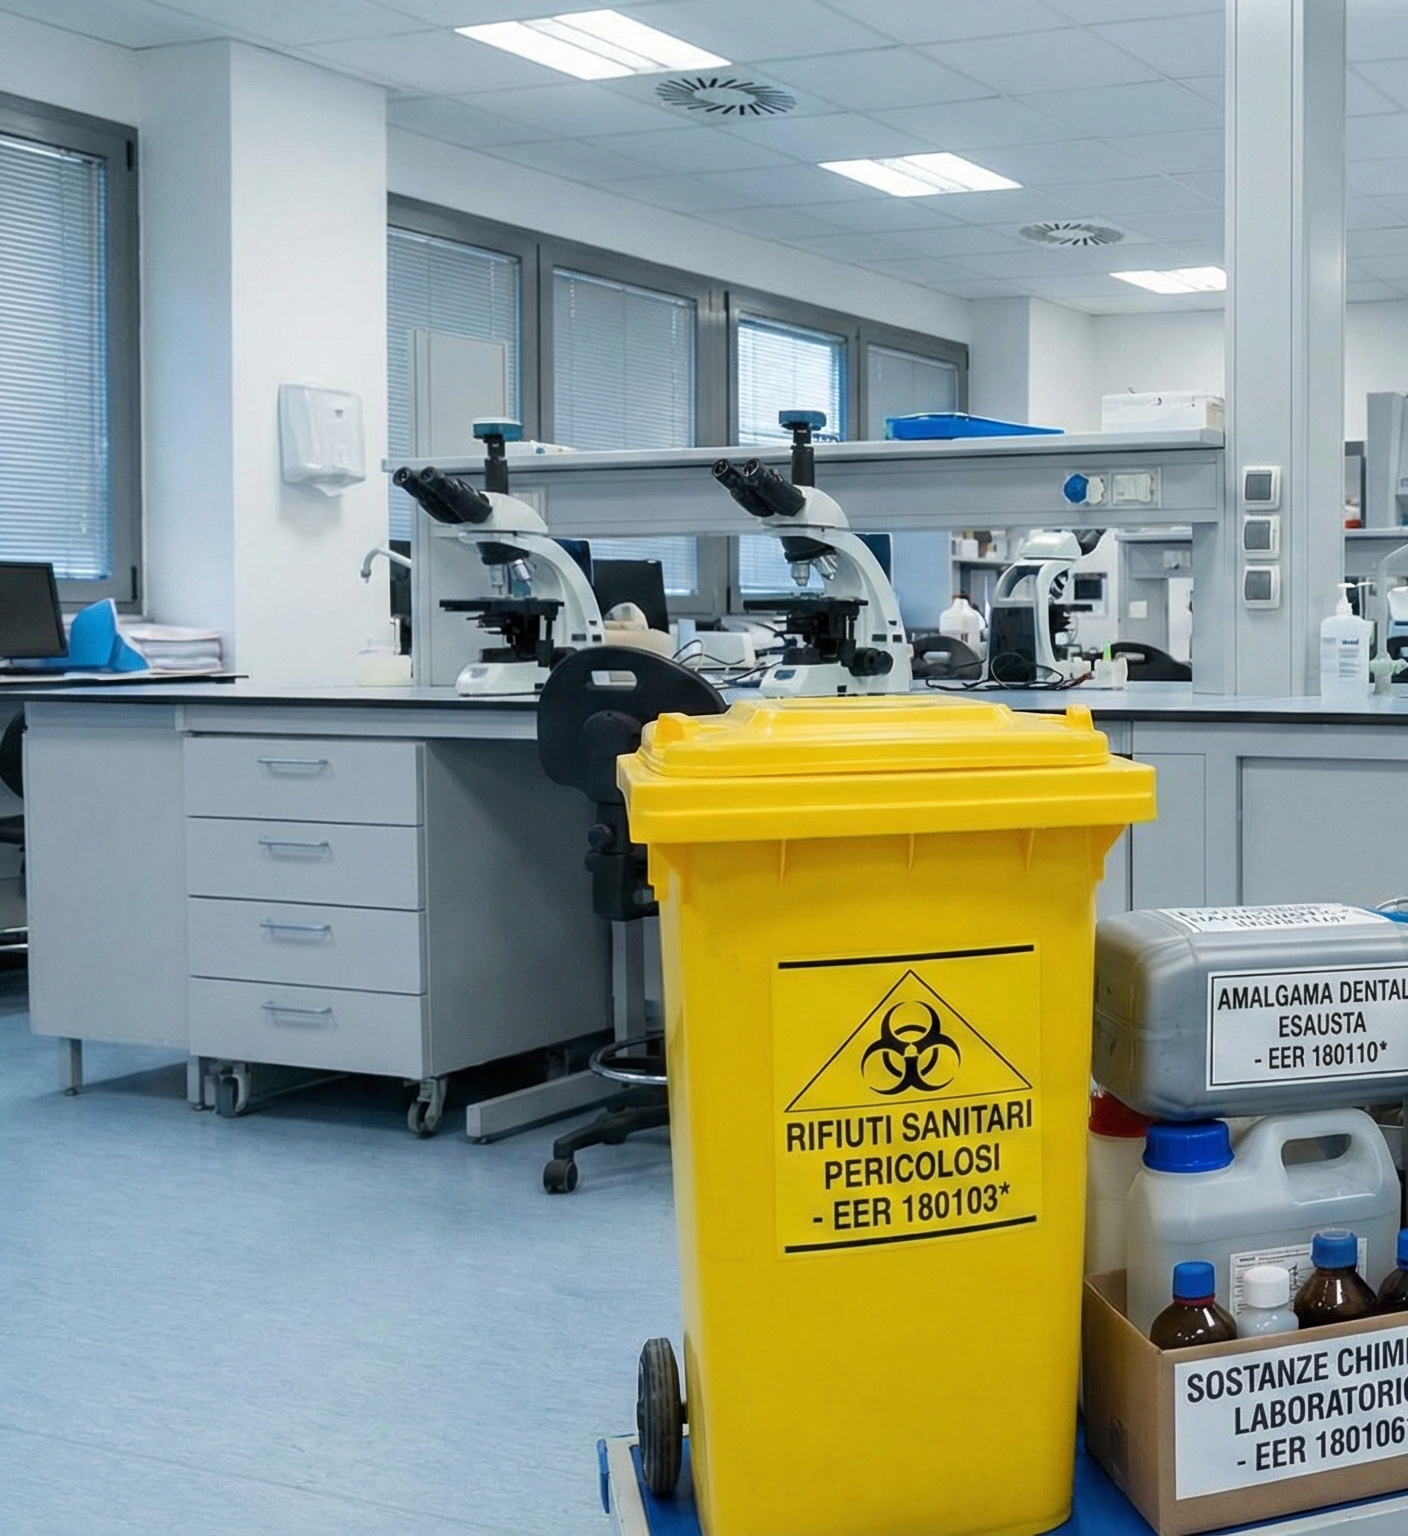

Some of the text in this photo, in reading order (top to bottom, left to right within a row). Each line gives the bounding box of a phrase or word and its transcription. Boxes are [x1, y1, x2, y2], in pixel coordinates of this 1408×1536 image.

[1217, 982, 1333, 1010] AMALGAMA
[1279, 1011, 1367, 1038] ESAUSTA
[1268, 1045, 1305, 1070] EER
[787, 1098, 1032, 1152] RIFIUTI SANITARI
[824, 1142, 1000, 1190] PERICOLOSI
[833, 1196, 891, 1230] EER
[1186, 1351, 1329, 1403] SOSTANZE
[1255, 1434, 1306, 1471] EER
